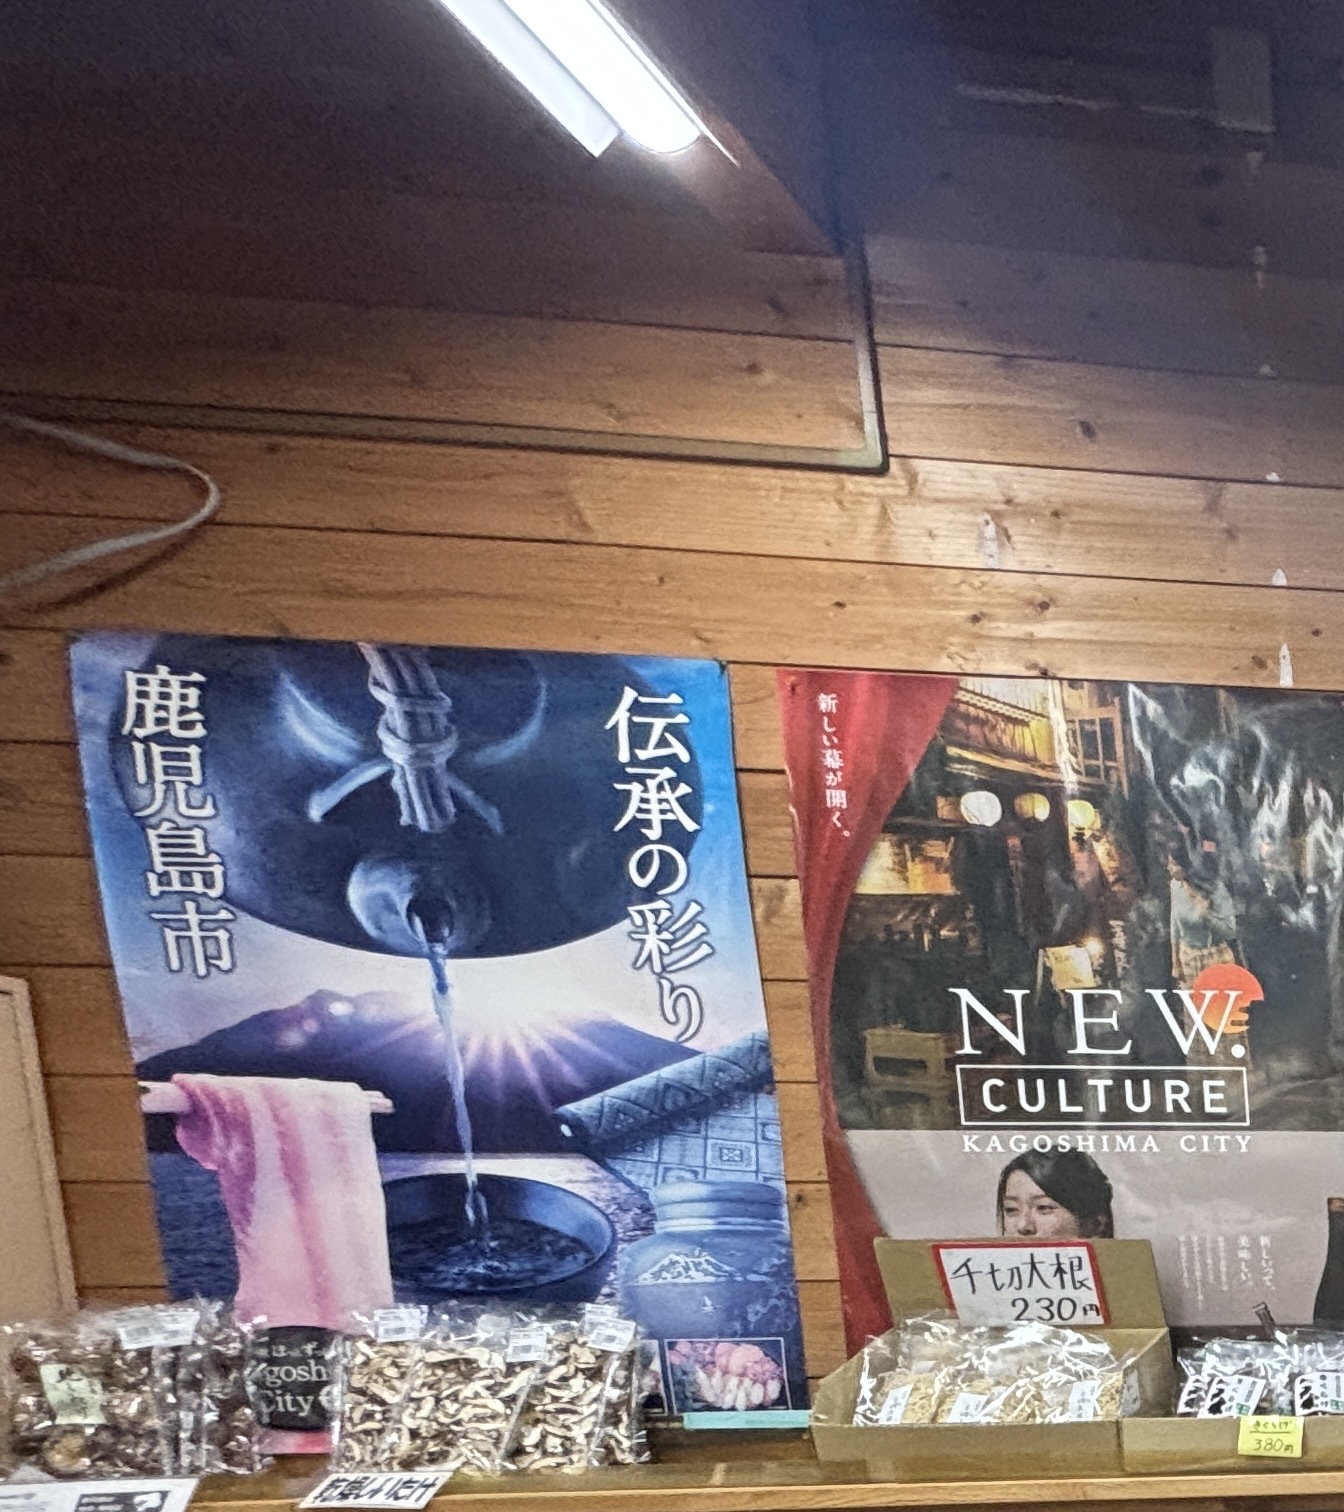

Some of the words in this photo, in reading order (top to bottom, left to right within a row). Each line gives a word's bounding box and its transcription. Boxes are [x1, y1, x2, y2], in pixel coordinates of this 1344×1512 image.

[817, 692, 852, 840] 新しい幕が開く。
[121, 665, 236, 980] 鹿児島市
[603, 686, 715, 1043] 伝承の彩り
[982, 1077, 1229, 1115] CULTURE
[962, 1134, 1160, 1154] KAGOSHIMA
[1179, 1134, 1252, 1154] CITY
[950, 1252, 1094, 1296] 千切大根
[1010, 1297, 1101, 1323] 230円
[1253, 1438, 1293, 1452] 380円
